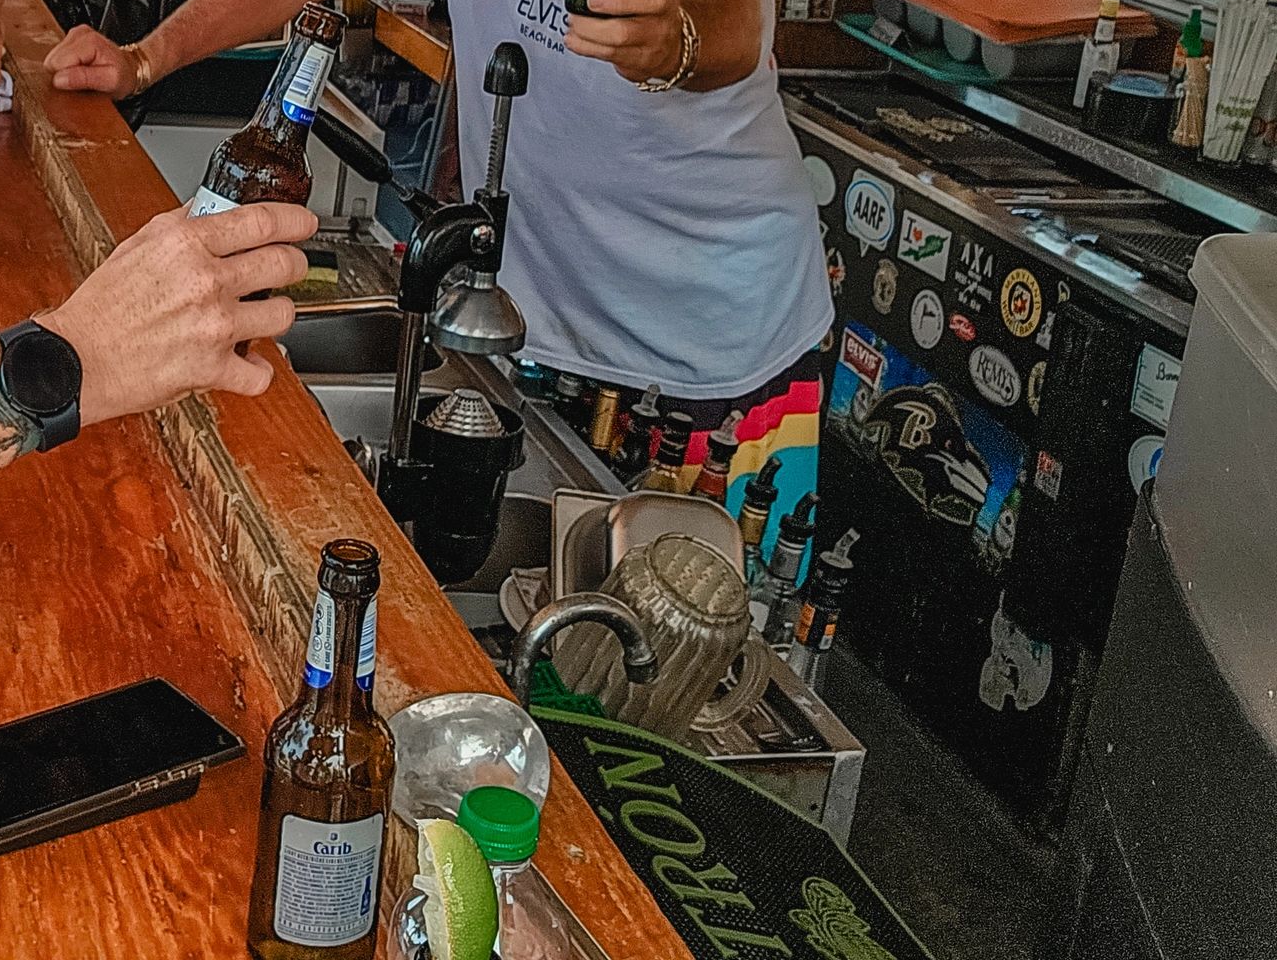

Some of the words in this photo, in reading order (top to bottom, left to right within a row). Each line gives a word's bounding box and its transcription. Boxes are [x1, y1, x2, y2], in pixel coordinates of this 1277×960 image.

[520, 24, 546, 47] BEACH
[546, 37, 565, 55] BAR
[853, 191, 886, 231] AARF
[313, 841, 352, 856] Carib
